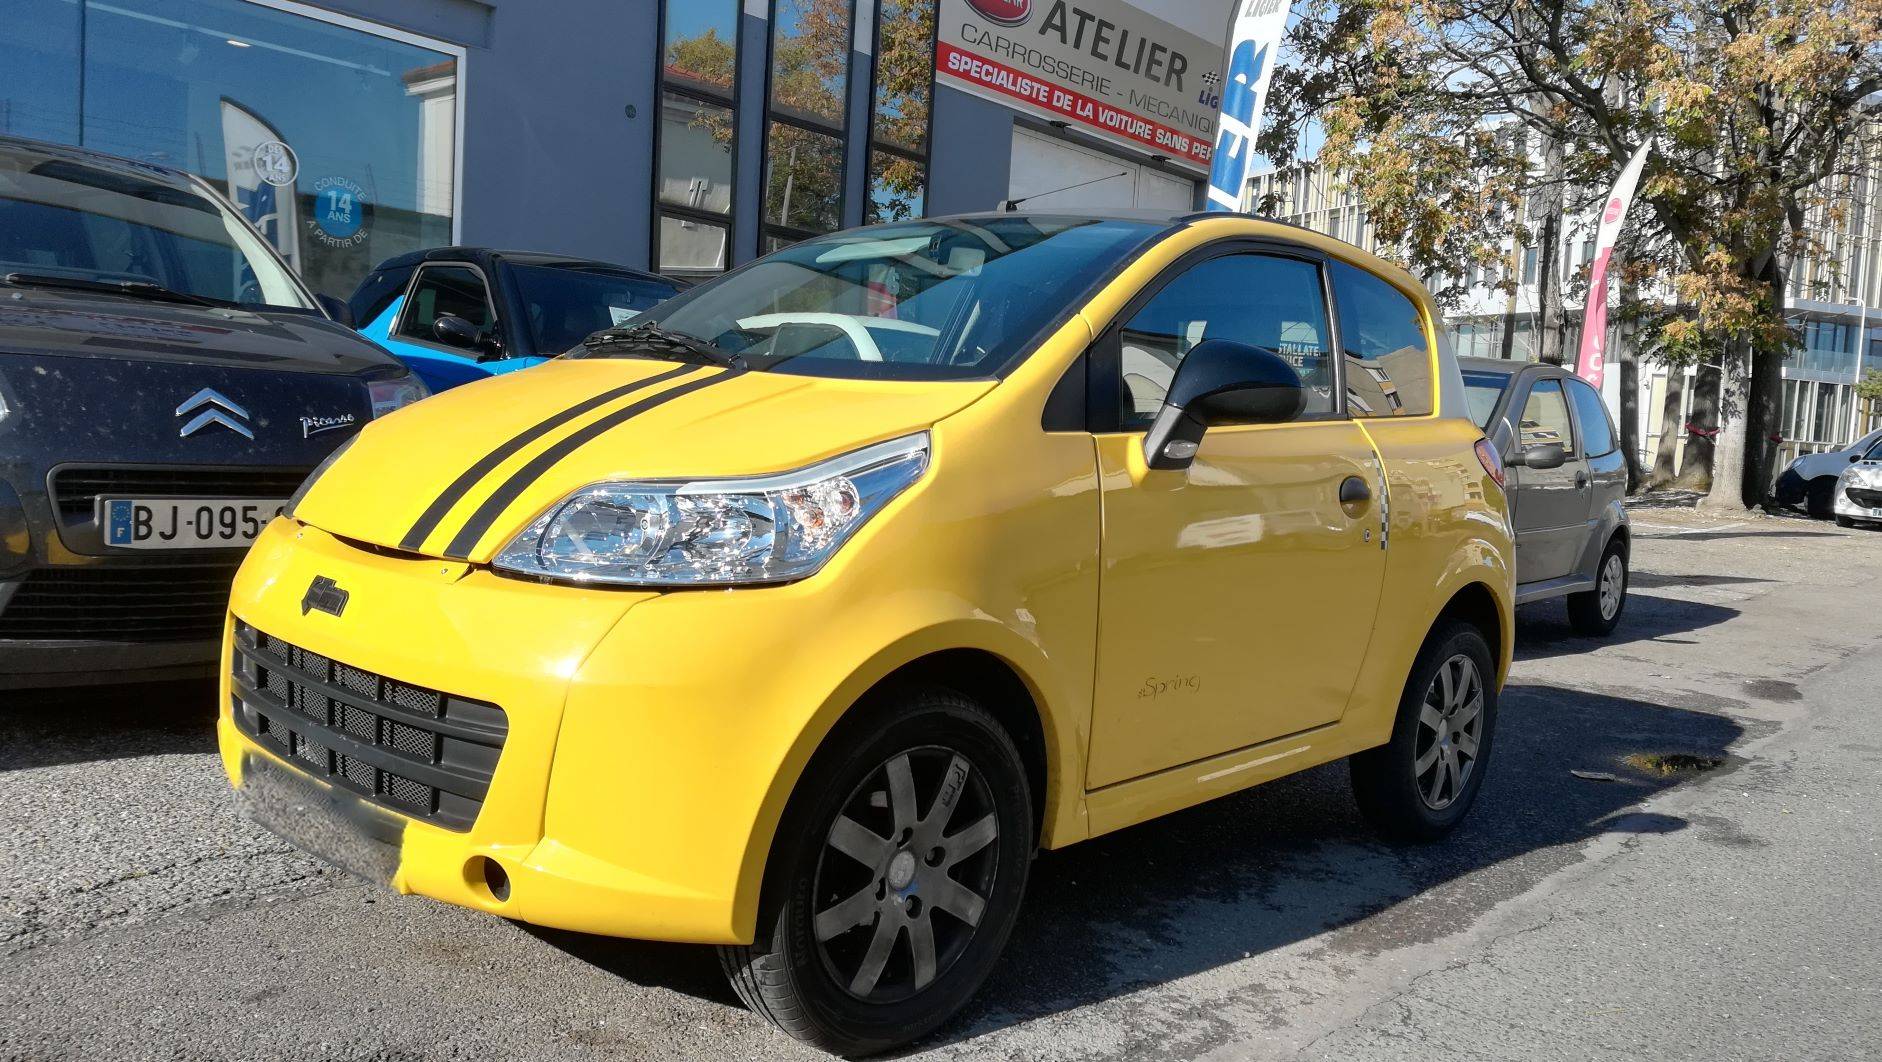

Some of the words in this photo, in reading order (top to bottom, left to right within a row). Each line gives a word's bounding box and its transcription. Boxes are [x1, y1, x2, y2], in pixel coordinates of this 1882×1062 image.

[1038, 0, 1188, 93] ATELIER
[961, 23, 1112, 97] CARROSSERIE
[947, 52, 1050, 103] SPECIALISTE
[1052, 90, 1074, 111] DE
[1076, 99, 1094, 119] LA
[1098, 107, 1153, 140] VOITURE
[1155, 129, 1190, 153] SANS
[262, 154, 290, 173] 14
[314, 176, 368, 201] CONDUITE
[327, 190, 352, 214] 14
[327, 210, 351, 223] ANS
[314, 228, 353, 249] PARTIR
[353, 228, 369, 244] DE
[116, 527, 125, 538] F
